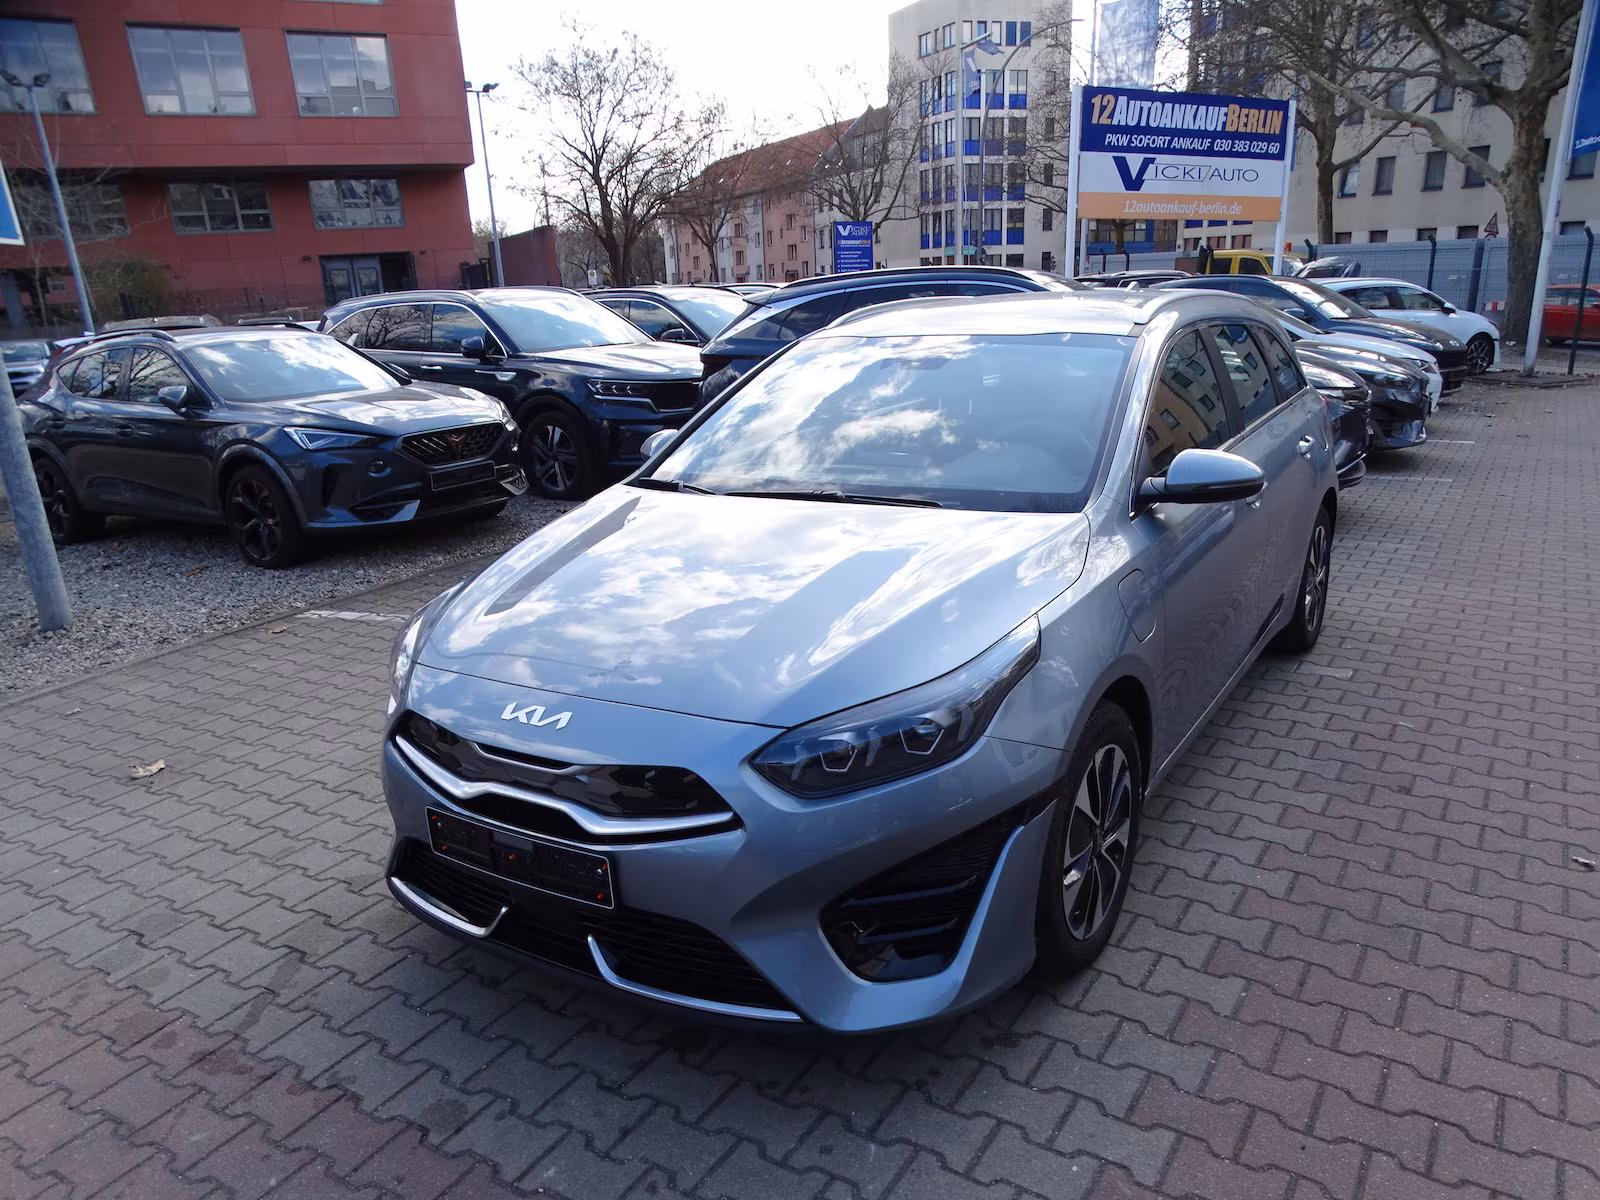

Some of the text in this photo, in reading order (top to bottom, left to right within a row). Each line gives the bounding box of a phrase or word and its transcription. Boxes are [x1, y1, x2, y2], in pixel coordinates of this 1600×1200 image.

[1104, 133, 1280, 154] PKW SOFORT ANKAUF 030 383 029 60
[1123, 200, 1242, 217] 12autoankauf-berlin.de
[500, 701, 573, 730] KIA
